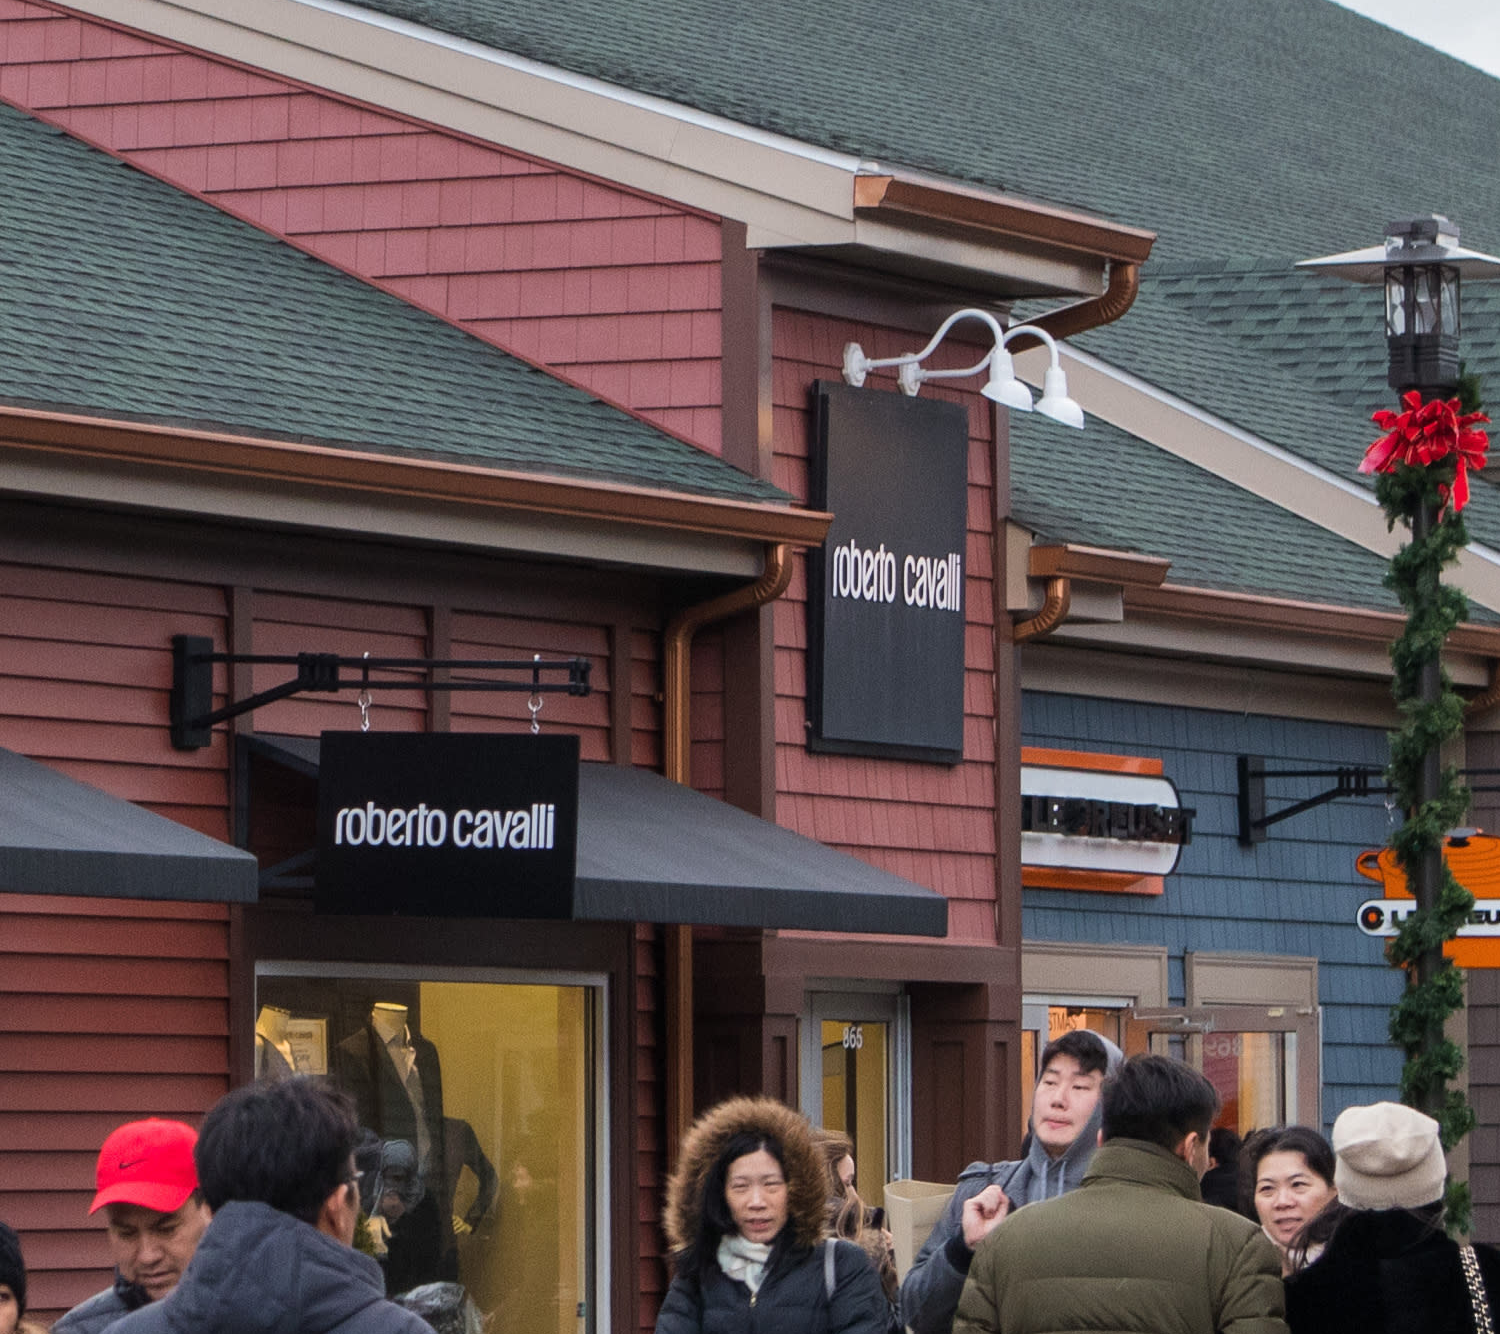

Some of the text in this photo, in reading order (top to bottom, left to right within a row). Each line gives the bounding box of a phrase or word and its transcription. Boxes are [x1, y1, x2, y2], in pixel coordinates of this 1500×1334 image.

[833, 539, 961, 612] roberto cavalli
[335, 801, 555, 849] roberto cavalli
